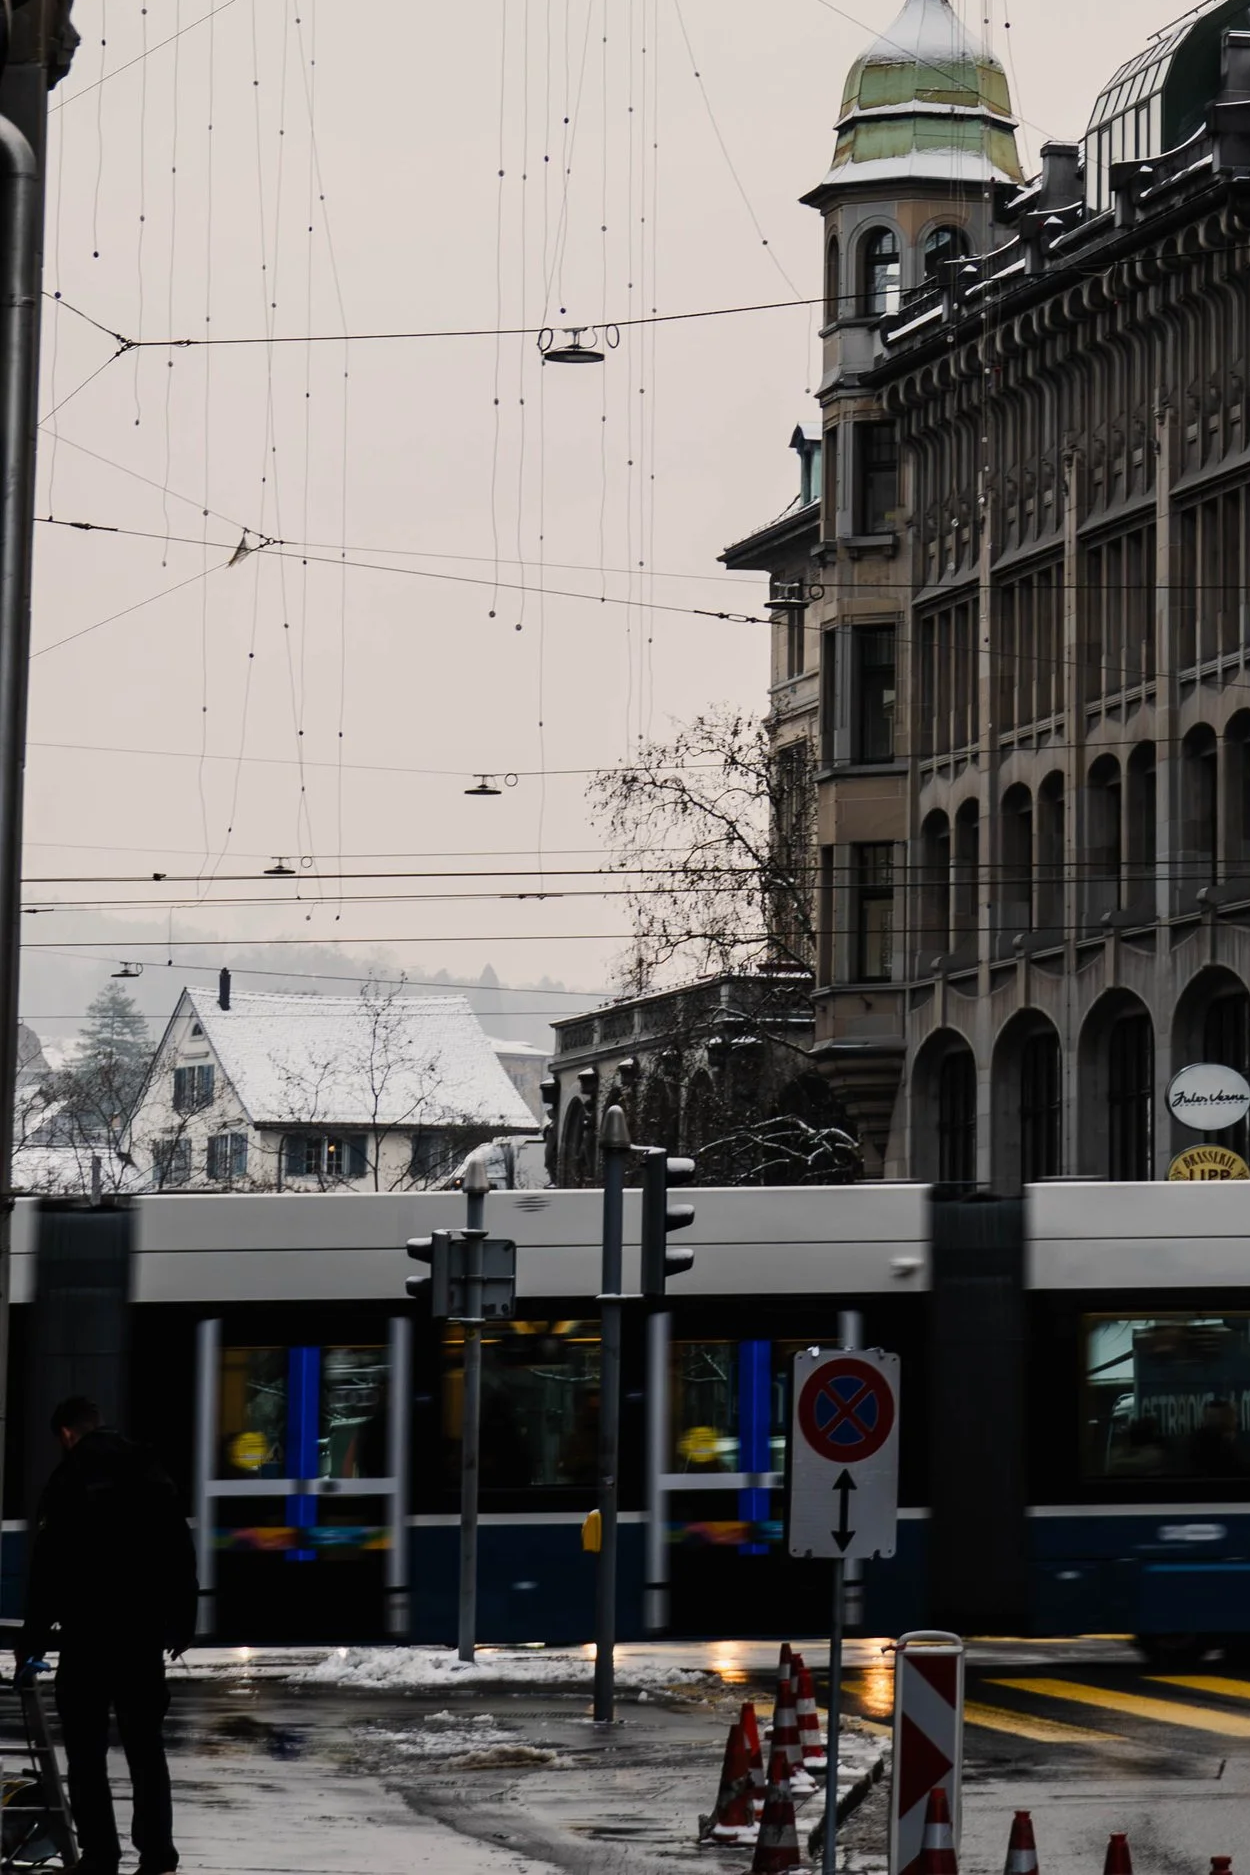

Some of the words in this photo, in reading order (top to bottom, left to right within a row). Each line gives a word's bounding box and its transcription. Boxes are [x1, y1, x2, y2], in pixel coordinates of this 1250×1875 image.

[1172, 1090, 1208, 1107] Jules
[1210, 1089, 1249, 1102] Verne
[1182, 1150, 1237, 1170] BRASSERIE
